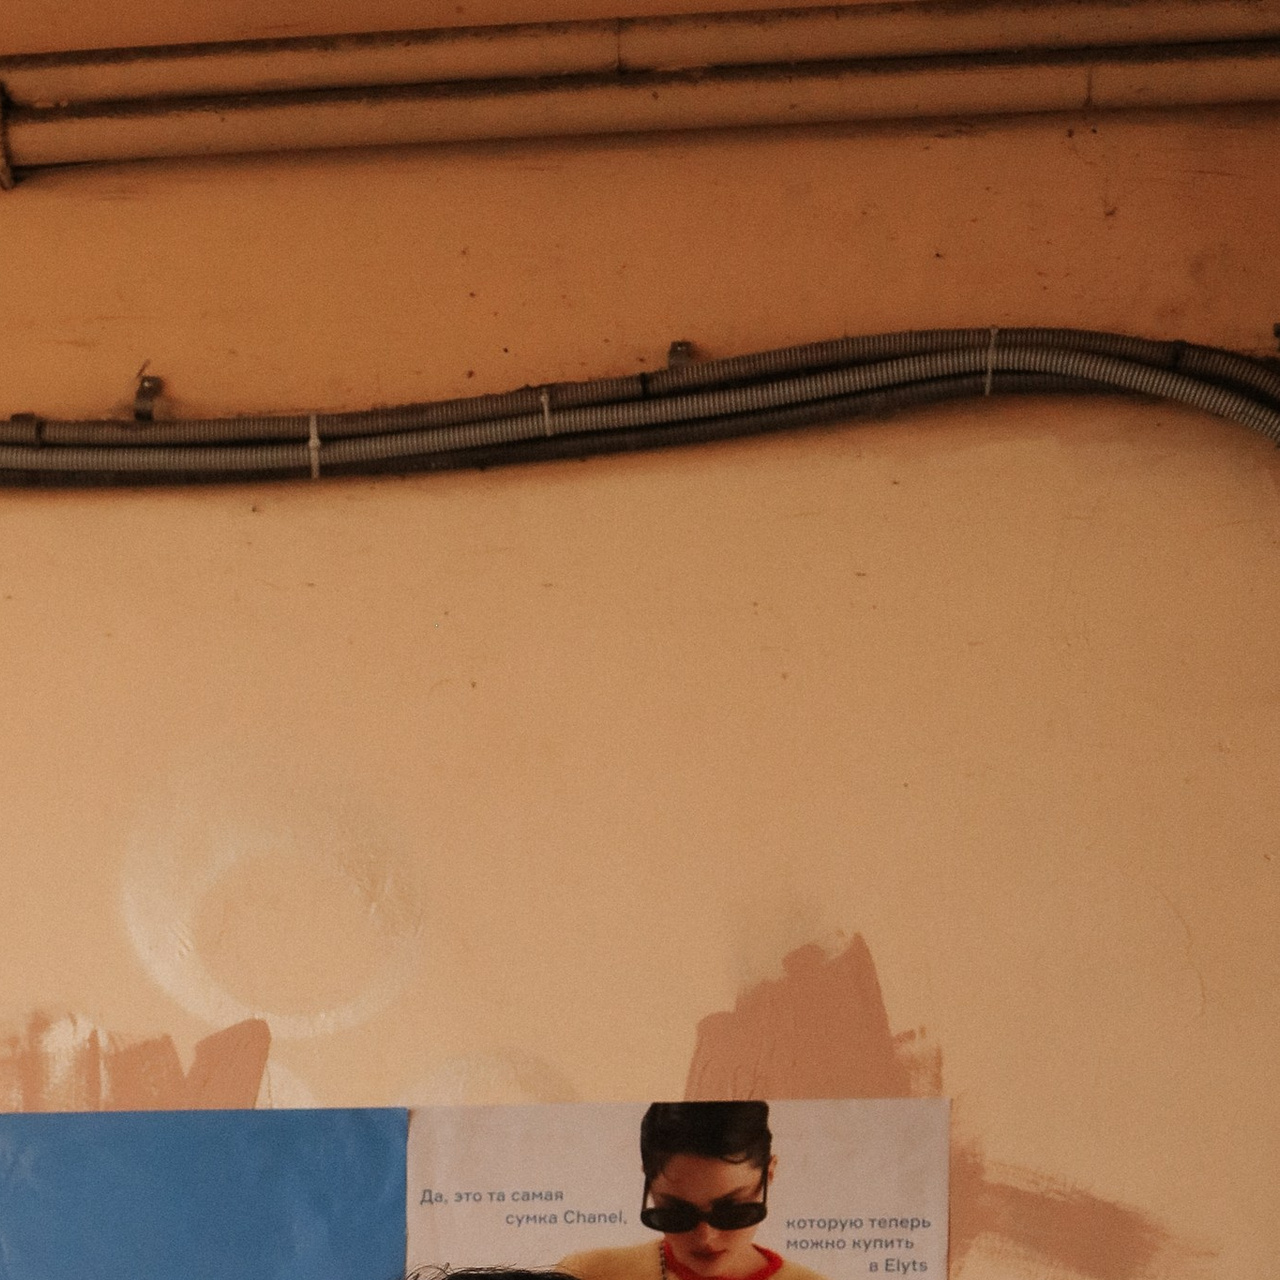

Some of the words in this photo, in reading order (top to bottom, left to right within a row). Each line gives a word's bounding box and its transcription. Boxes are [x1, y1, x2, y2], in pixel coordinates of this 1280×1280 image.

[420, 1189, 448, 1205] Да,
[454, 1192, 482, 1201] это
[488, 1191, 505, 1201] та
[511, 1190, 564, 1200] самая
[505, 1212, 557, 1227] сумка
[786, 1217, 863, 1231] которую
[869, 1217, 931, 1231] теперь
[786, 1238, 846, 1249] можно
[852, 1238, 914, 1251] купить
[869, 1261, 879, 1272] в
[885, 1258, 928, 1275] Elyts
